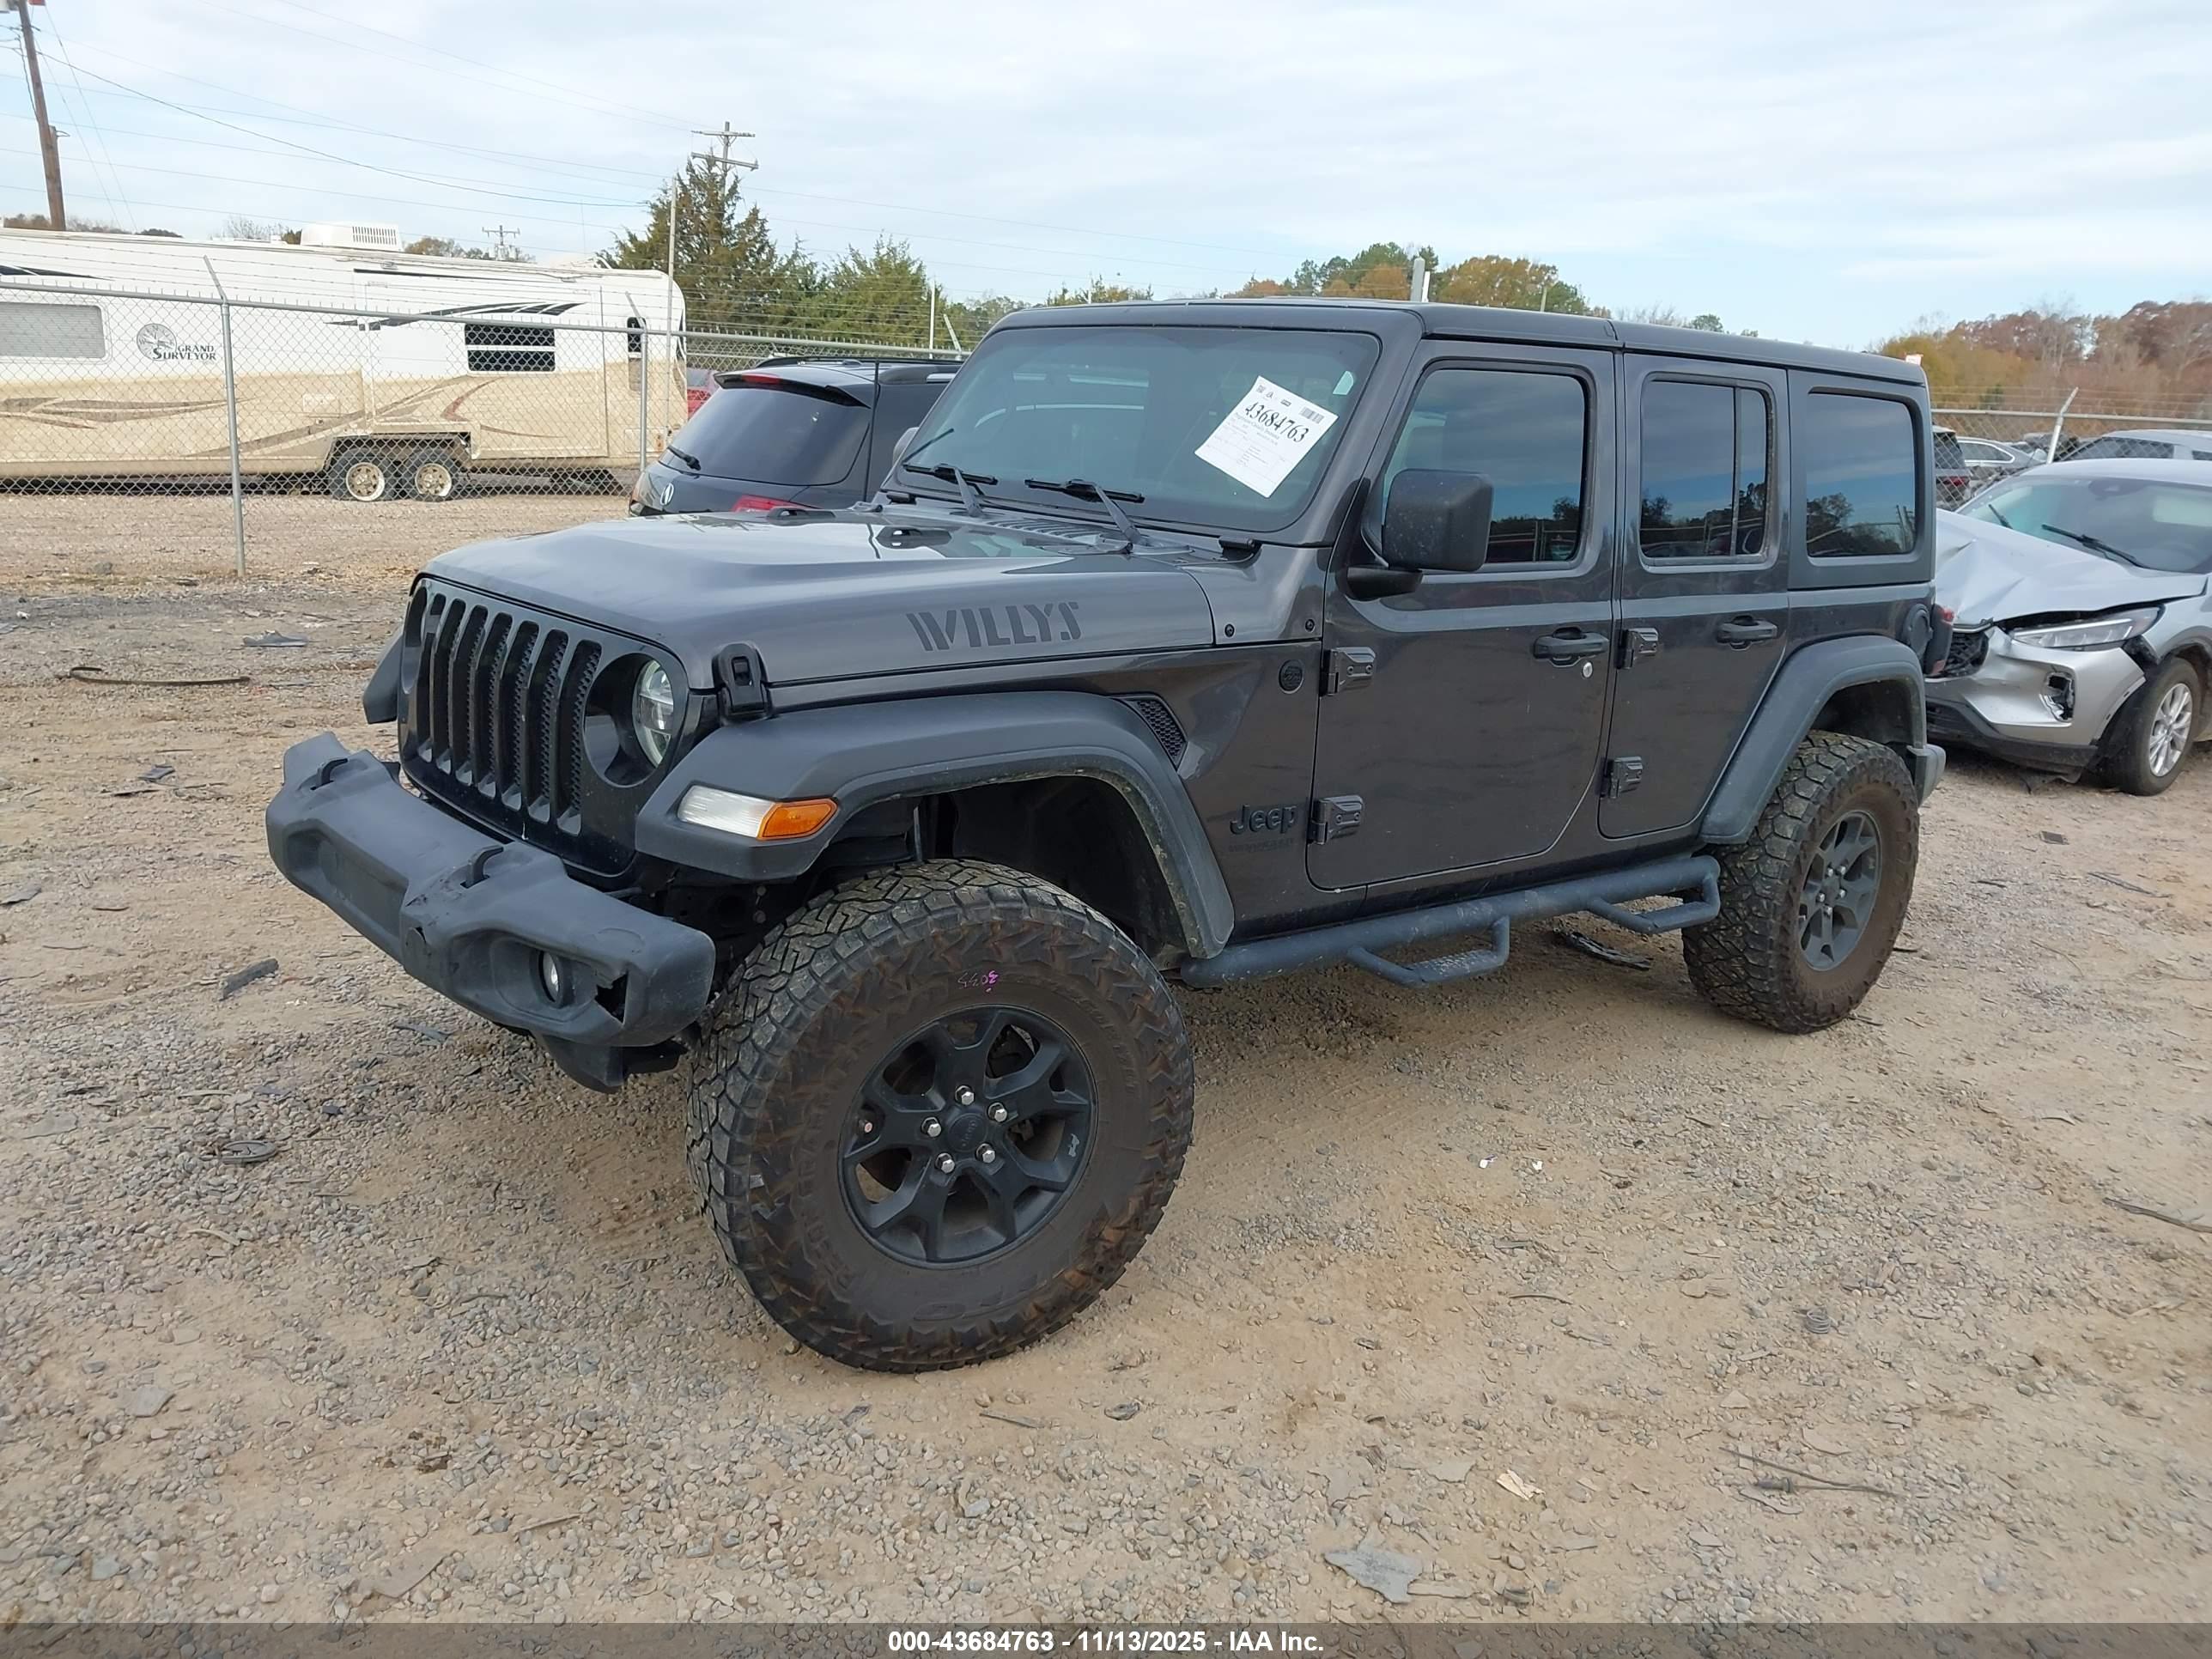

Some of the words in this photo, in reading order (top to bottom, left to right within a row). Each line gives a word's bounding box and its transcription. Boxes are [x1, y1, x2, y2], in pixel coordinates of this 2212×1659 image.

[152, 347, 216, 361] SURVEYOR
[1245, 401, 1310, 443] 43684763
[905, 601, 1082, 651] WILLYS
[1229, 804, 1297, 835] Jeep
